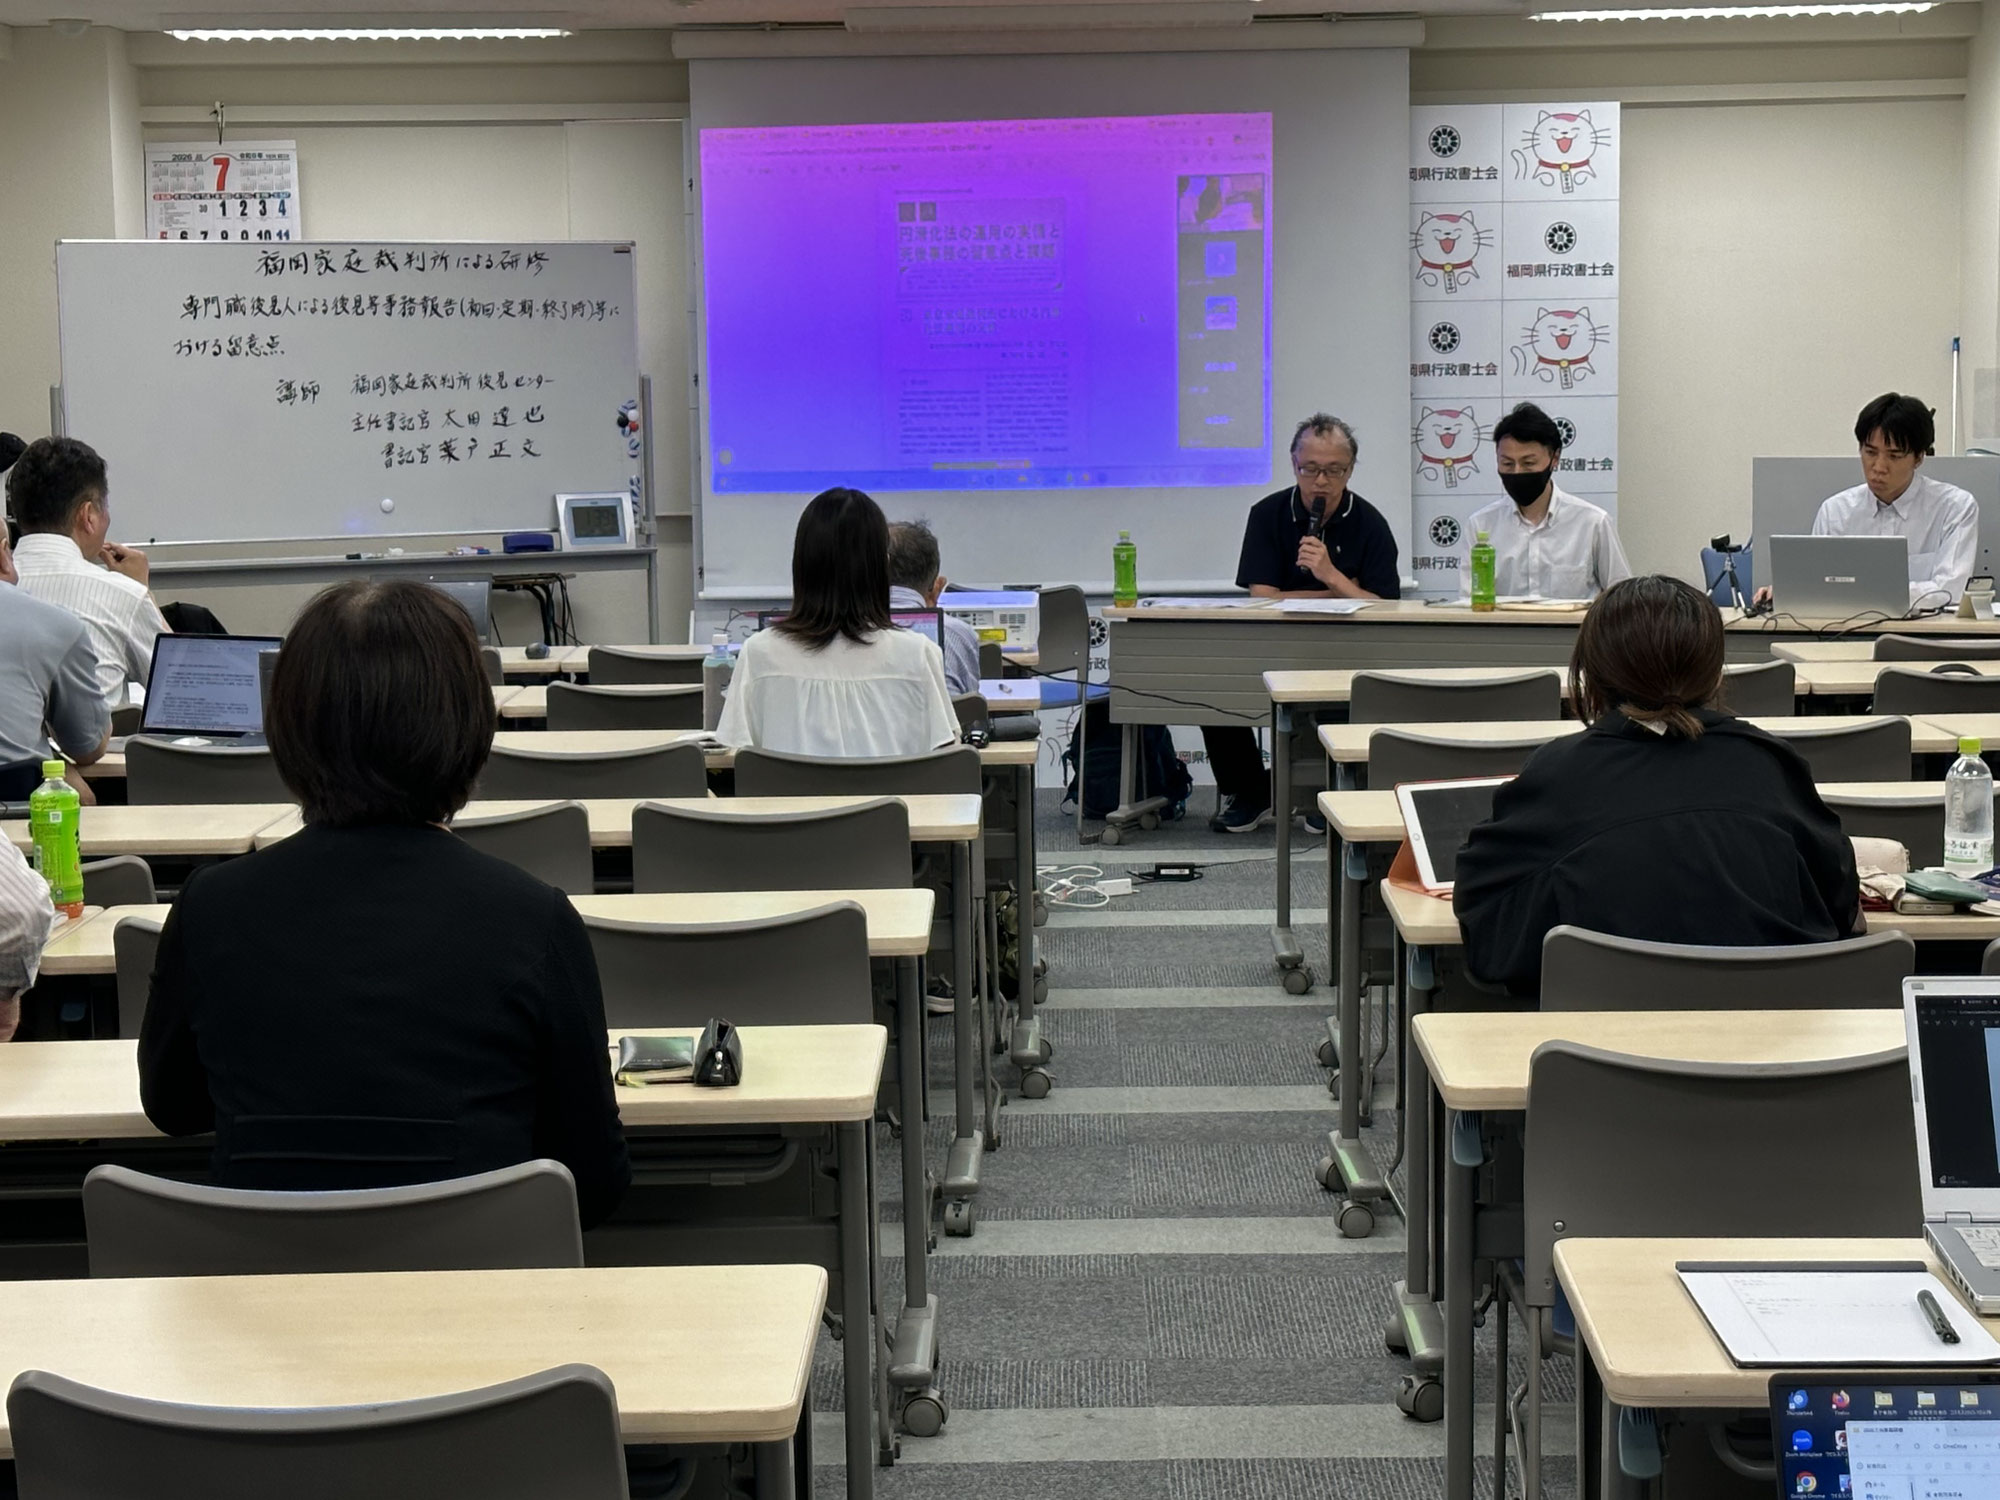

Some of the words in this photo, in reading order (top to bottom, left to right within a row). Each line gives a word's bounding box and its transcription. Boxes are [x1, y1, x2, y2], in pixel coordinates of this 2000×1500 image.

[172, 153, 192, 161] 2026
[213, 157, 230, 192] 7
[199, 204, 208, 213] 30
[219, 199, 226, 217] 1
[239, 200, 248, 217] 2
[259, 200, 267, 217] 3
[278, 200, 287, 216] 4
[256, 249, 549, 277] 福岡家庭裁判所による研修
[1506, 262, 1614, 278] 福岡県行政書士会
[174, 333, 285, 357] おける留意点
[276, 379, 320, 405] 講師
[352, 411, 430, 432] 主任書記官
[381, 442, 431, 469] 書記官
[1412, 556, 1461, 570] 県行政
